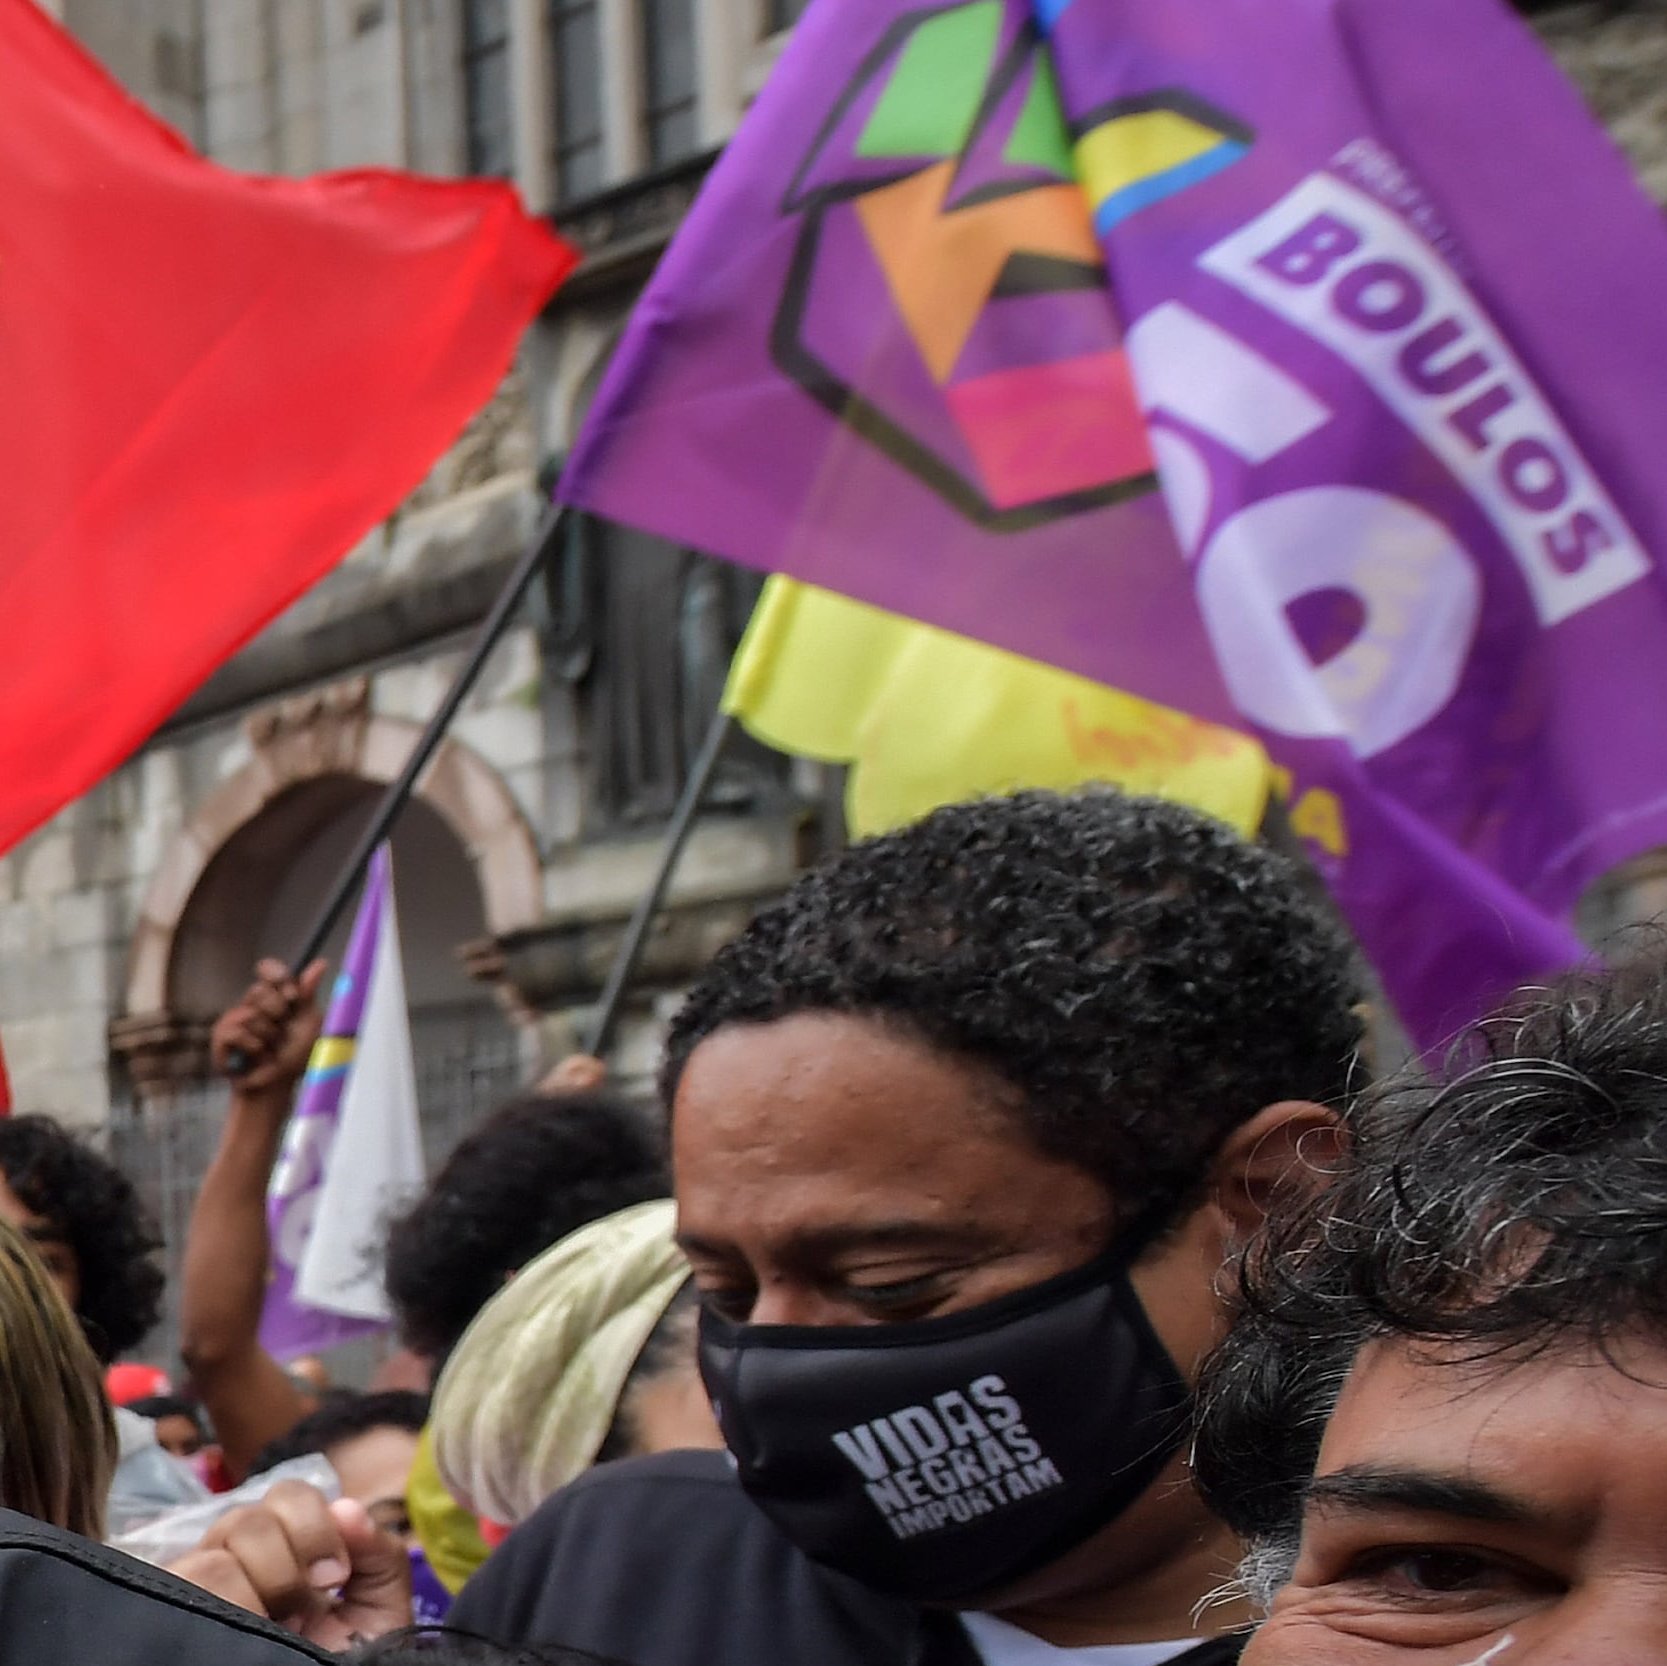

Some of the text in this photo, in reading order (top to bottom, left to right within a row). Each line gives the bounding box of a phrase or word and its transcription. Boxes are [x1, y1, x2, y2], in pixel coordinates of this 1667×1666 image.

[1252, 210, 1613, 576] BOULOS
[831, 1374, 1023, 1481] VIDAS
[864, 1424, 1043, 1515] NEGRAS
[886, 1457, 1065, 1540] IMPORTAM
